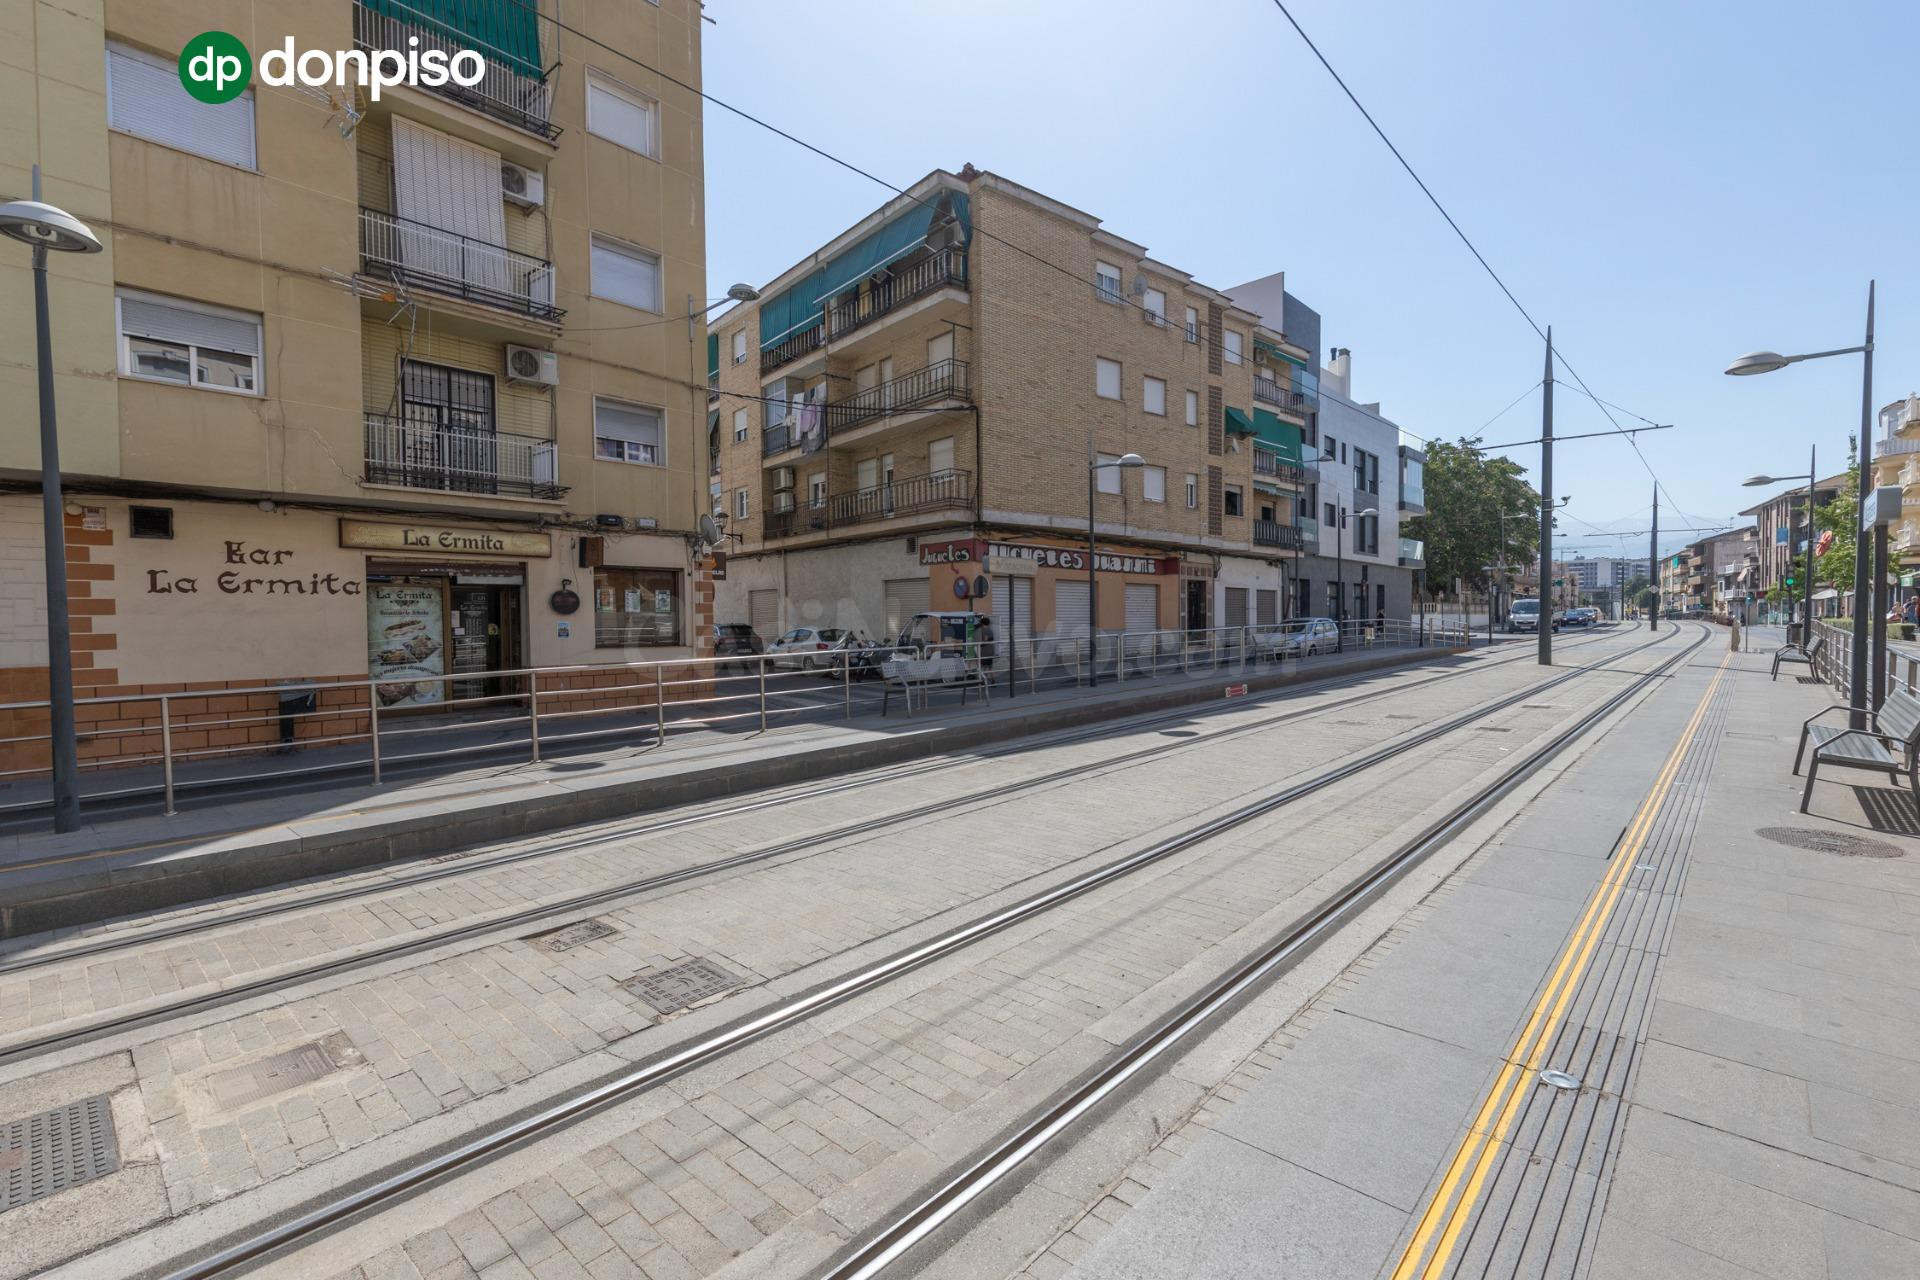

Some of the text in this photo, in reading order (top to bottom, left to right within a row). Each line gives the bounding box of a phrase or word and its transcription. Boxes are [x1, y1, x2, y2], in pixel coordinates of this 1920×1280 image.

[401, 529, 431, 546] La
[438, 530, 505, 551] Ermita
[223, 540, 294, 565] Bar
[146, 568, 362, 596] La Ermita
[376, 590, 433, 600] La Ermita
